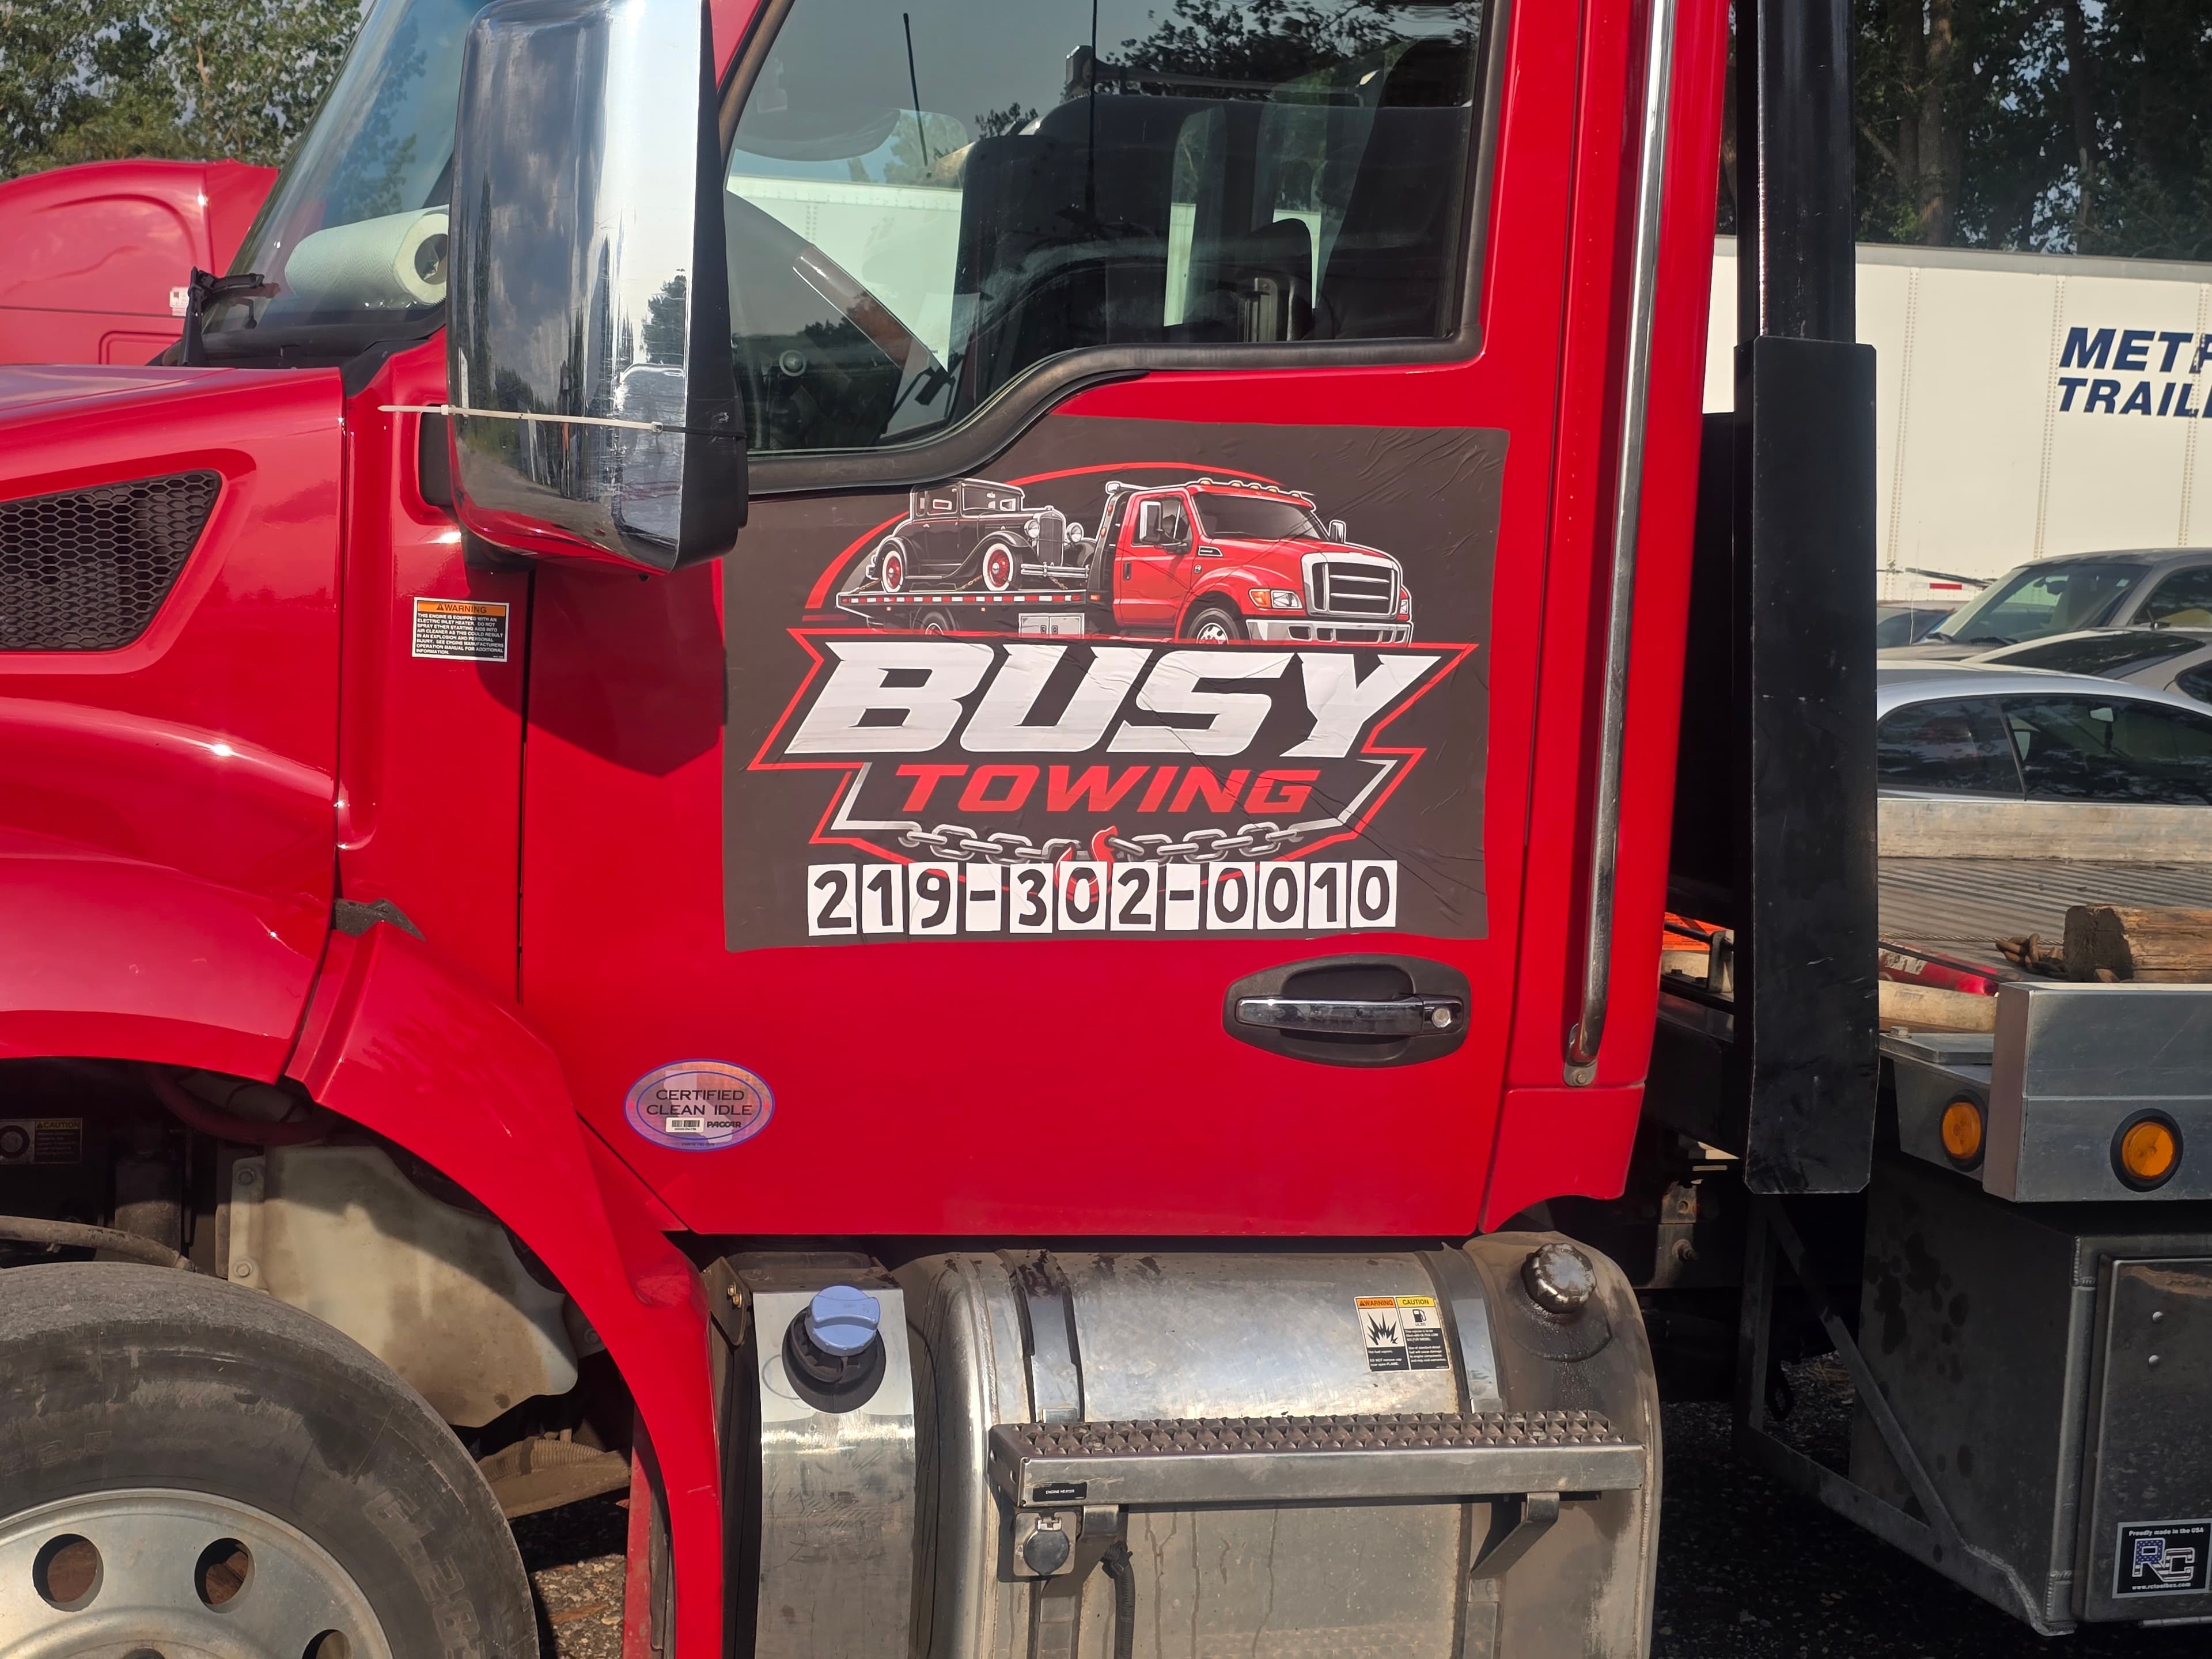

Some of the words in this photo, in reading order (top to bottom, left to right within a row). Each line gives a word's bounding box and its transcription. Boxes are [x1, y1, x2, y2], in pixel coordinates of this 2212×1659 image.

[445, 604, 486, 613] WARNING
[785, 641, 1441, 759] BUSY
[895, 764, 1321, 814] TOWING
[814, 866, 1391, 929] 219-302-0010
[646, 1105, 705, 1115] CLEAN
[714, 1105, 752, 1115] IDLE
[656, 1090, 744, 1100] CERTIFIED
[2132, 1537, 2195, 1582] RC
